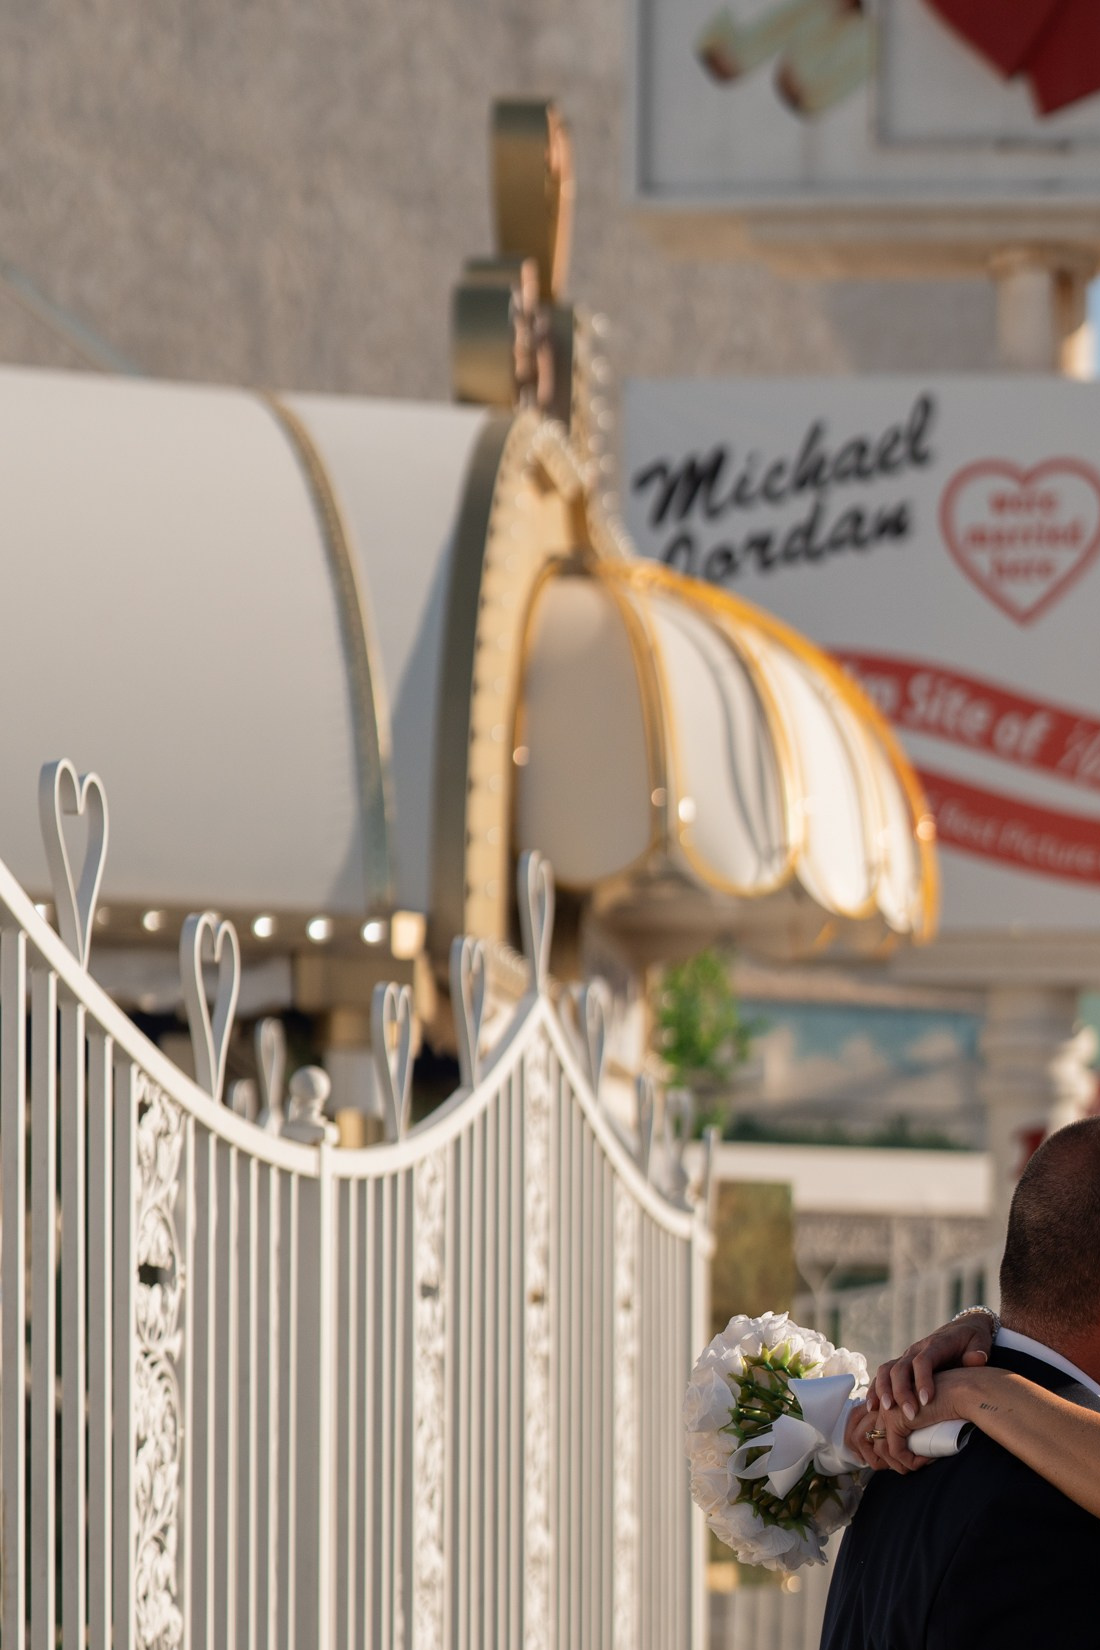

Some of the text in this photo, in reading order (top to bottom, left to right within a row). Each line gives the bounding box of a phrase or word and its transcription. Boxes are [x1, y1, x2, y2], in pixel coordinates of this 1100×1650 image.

[632, 391, 934, 528] Michael
[966, 518, 1083, 549] married
[905, 672, 992, 745] Site
[993, 708, 1052, 766] of
[999, 818, 1096, 876] Picture
